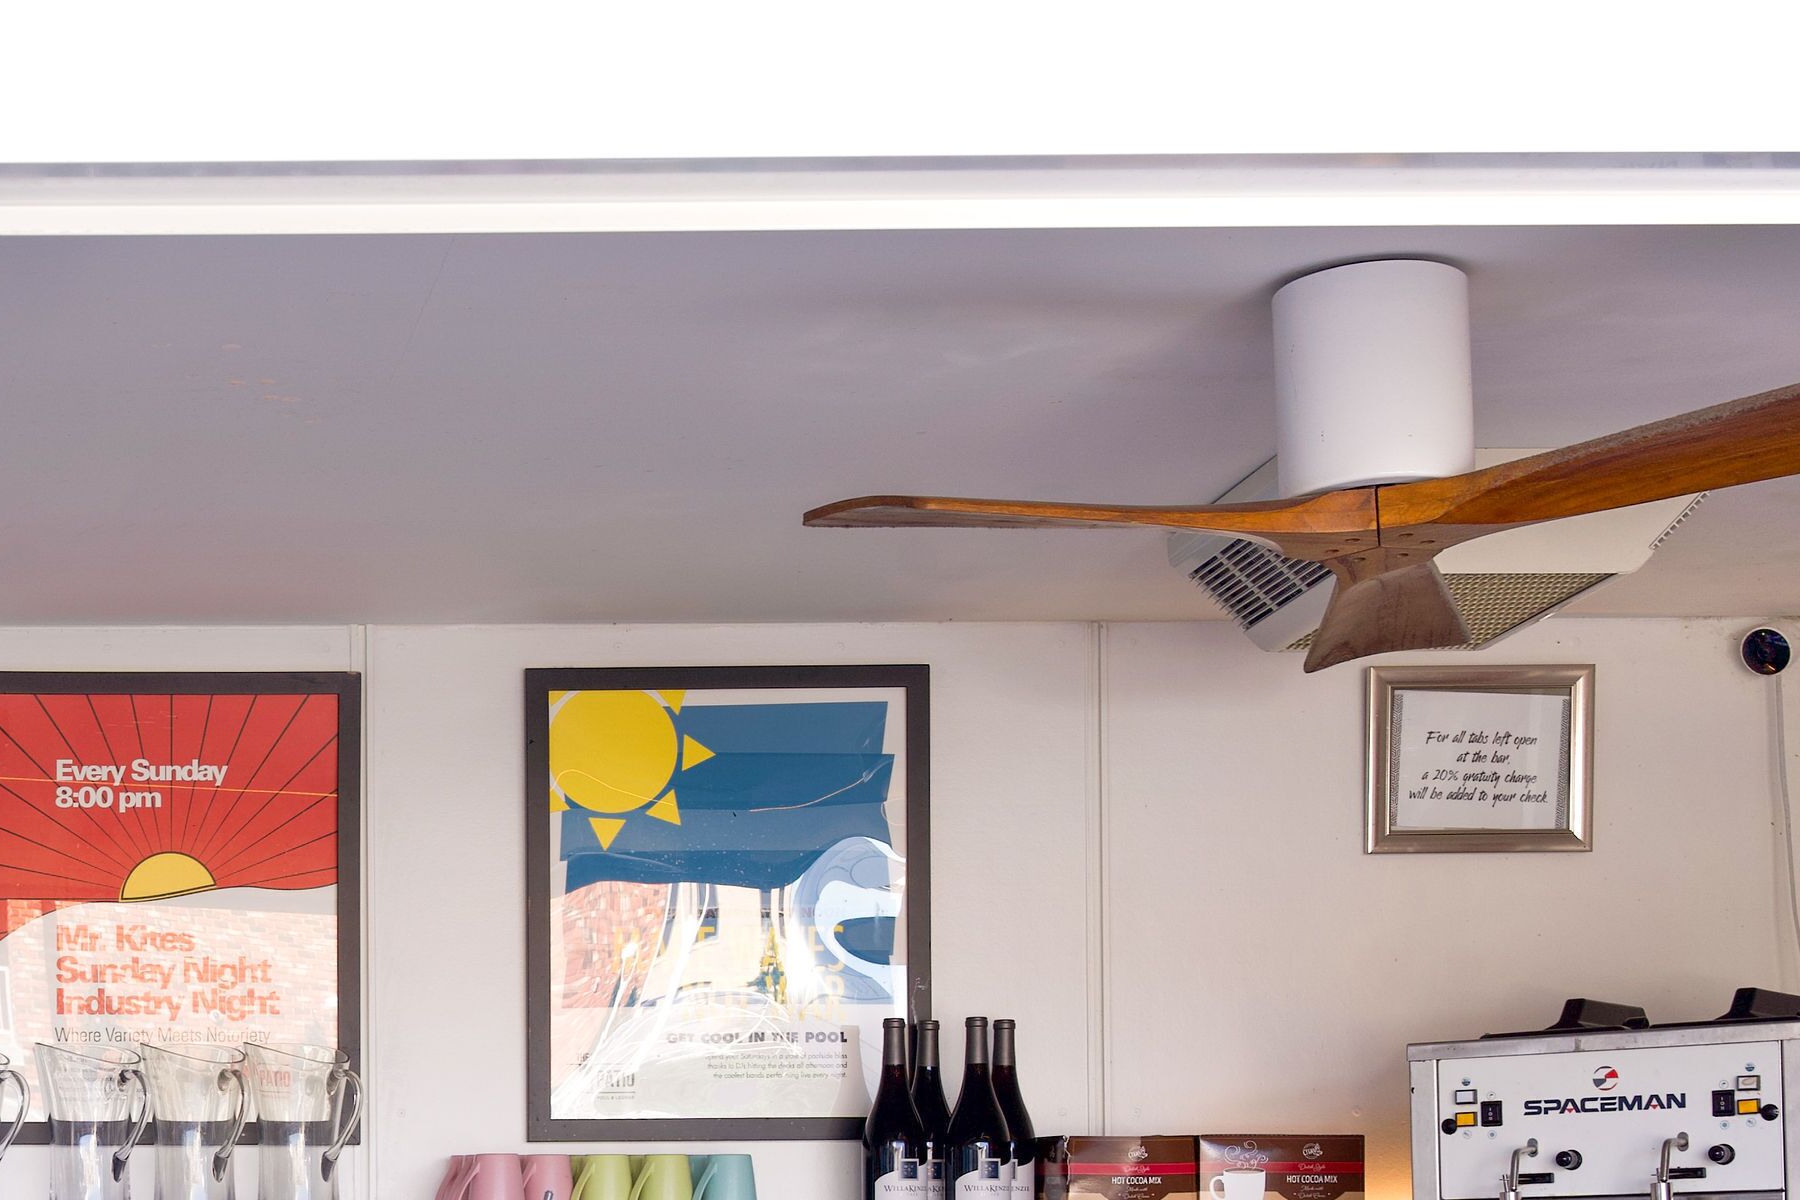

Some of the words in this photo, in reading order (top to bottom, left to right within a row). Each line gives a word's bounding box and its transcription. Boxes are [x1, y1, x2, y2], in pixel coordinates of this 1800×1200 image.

[1426, 731, 1449, 745] For
[1452, 731, 1466, 744] all
[1469, 731, 1488, 745] tabs
[1492, 731, 1512, 746] left
[1514, 736, 1538, 749] open
[1456, 752, 1469, 763] at
[1472, 751, 1487, 763] the
[55, 759, 126, 786] Every
[131, 759, 228, 787] Sunday
[1421, 771, 1429, 780] a
[1432, 769, 1458, 780] 20%
[1463, 771, 1500, 788] gratuity
[1504, 770, 1537, 787] charge
[55, 788, 113, 808] 8:00
[119, 791, 162, 813] pm
[1409, 787, 1428, 800] will
[1430, 787, 1443, 800] be
[1447, 787, 1477, 801] added
[1478, 790, 1488, 801] to
[1492, 793, 1516, 807] your
[55, 925, 106, 952] Mr.
[55, 956, 176, 989] Sunday
[183, 956, 272, 990] Night
[55, 988, 185, 1021] Industry
[192, 988, 280, 1021] Night
[55, 1027, 101, 1042] Where
[105, 1027, 152, 1046] Variety
[157, 1027, 202, 1042] Meets
[206, 1027, 271, 1046] Notoriety
[749, 1032, 765, 1043] IN
[805, 1031, 847, 1043] POOL
[1524, 1093, 1686, 1115] SPACEMAN
[1111, 1176, 1126, 1184] HOT
[1126, 1176, 1148, 1185] COCOA
[1148, 1176, 1162, 1184] MIX
[1286, 1175, 1300, 1183] HOT
[1301, 1175, 1323, 1183] COCOA
[1324, 1175, 1338, 1183] MIX
